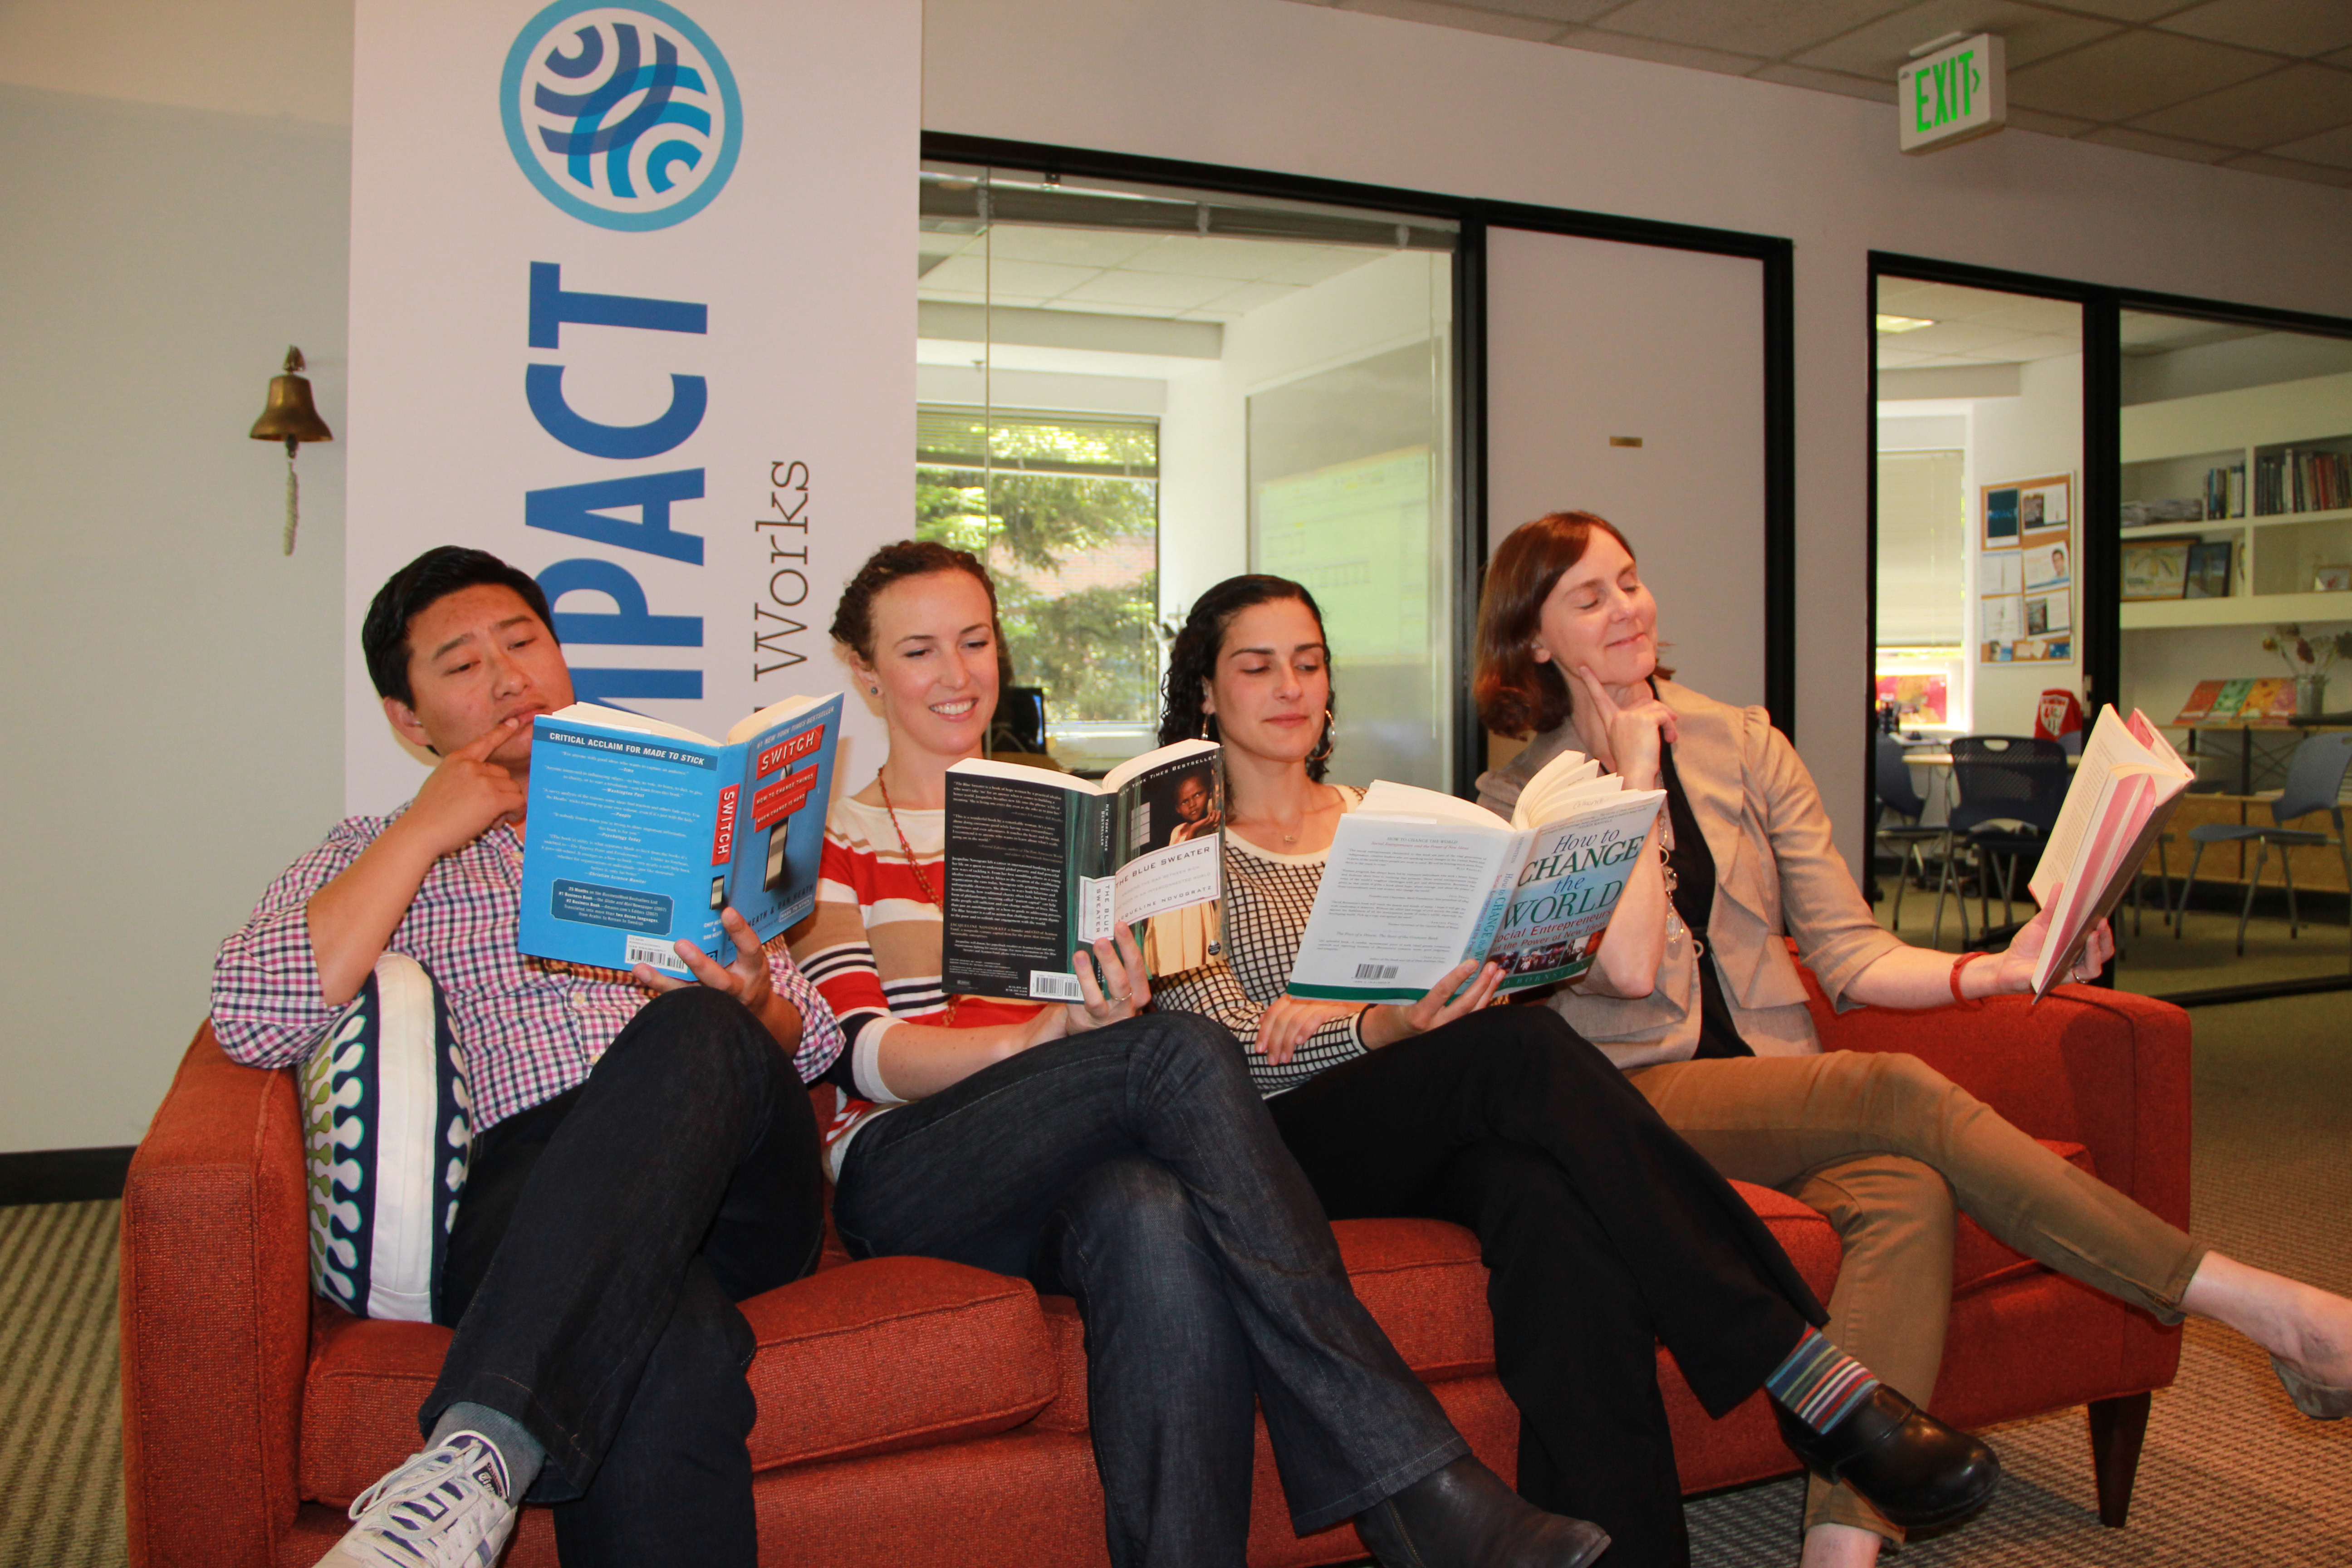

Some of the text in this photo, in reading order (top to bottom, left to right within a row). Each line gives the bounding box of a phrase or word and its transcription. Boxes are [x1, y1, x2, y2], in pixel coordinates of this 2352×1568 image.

[1915, 49, 1974, 132] EXIT
[754, 460, 809, 681] Works
[764, 734, 776, 745] NEW
[806, 706, 834, 724] BESTSELLER
[550, 732, 585, 745] CRITICAL
[588, 739, 623, 750] ACCLAIM
[626, 745, 641, 754] FOR
[643, 748, 666, 758] MADE
[681, 755, 704, 765] STICK
[761, 731, 814, 771] SWITCH
[757, 795, 767, 805] HOW
[776, 781, 795, 795] CHANGE
[797, 773, 813, 785] THINGS
[1119, 788, 1129, 797] NEW
[1132, 779, 1147, 788] YORK
[1172, 755, 1217, 771] BESTSELLER
[718, 791, 735, 854] SWITCH
[757, 813, 769, 823] WHEN
[771, 804, 787, 816] CHANGE
[794, 794, 805, 803] HARD
[1551, 829, 1620, 854] How to
[1115, 847, 1210, 888] THE BLUE SWEATER
[1163, 870, 1186, 879] BETWEEN
[1517, 835, 1645, 887] CHANGE
[778, 897, 790, 910] DAN
[793, 884, 813, 901] HEATH
[1147, 877, 1192, 893] INTERCONNECTED
[1502, 873, 1514, 892] How
[1554, 875, 1585, 894] the
[1117, 885, 1211, 923] ACQUELINE NOVOGRATZ
[1483, 897, 1506, 938] CHANGE
[1504, 880, 1622, 931] WORLD
[704, 920, 713, 928] CHIP
[1521, 937, 1548, 946] Power
[1586, 921, 1606, 931] Ideas
[1531, 909, 1611, 936] Entrepreneurs
[1516, 963, 1585, 983] BORNSTEIN
[478, 1471, 495, 1492] Tige
